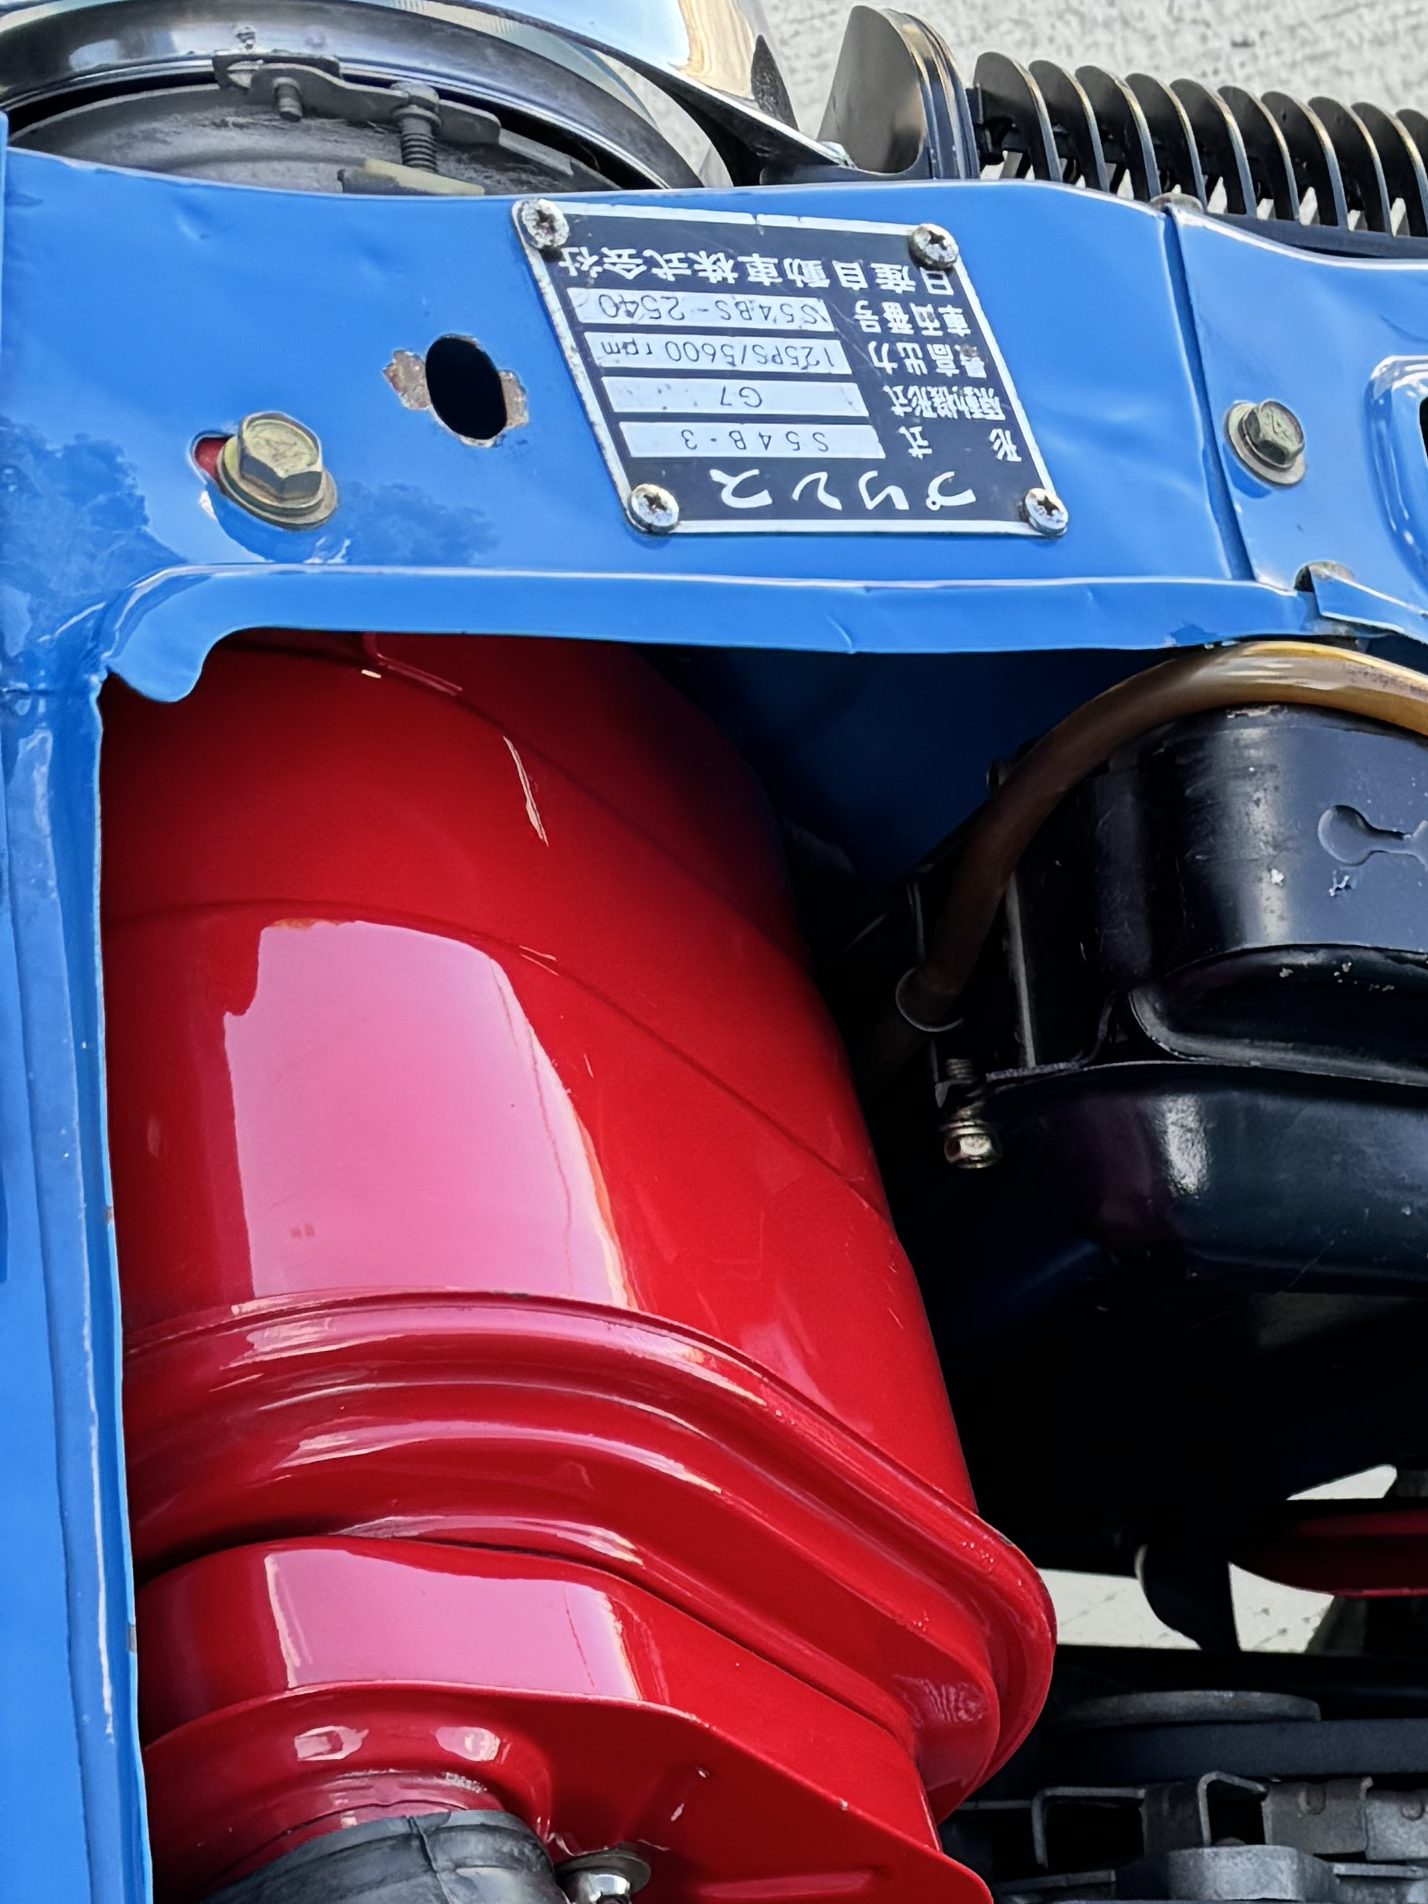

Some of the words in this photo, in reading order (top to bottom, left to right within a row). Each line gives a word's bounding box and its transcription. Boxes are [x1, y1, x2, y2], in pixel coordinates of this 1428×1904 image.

[557, 245, 953, 295] 日産自動車株式会社
[601, 340, 652, 358] rpm
[718, 386, 762, 407] G7
[709, 469, 976, 511] プリンス
